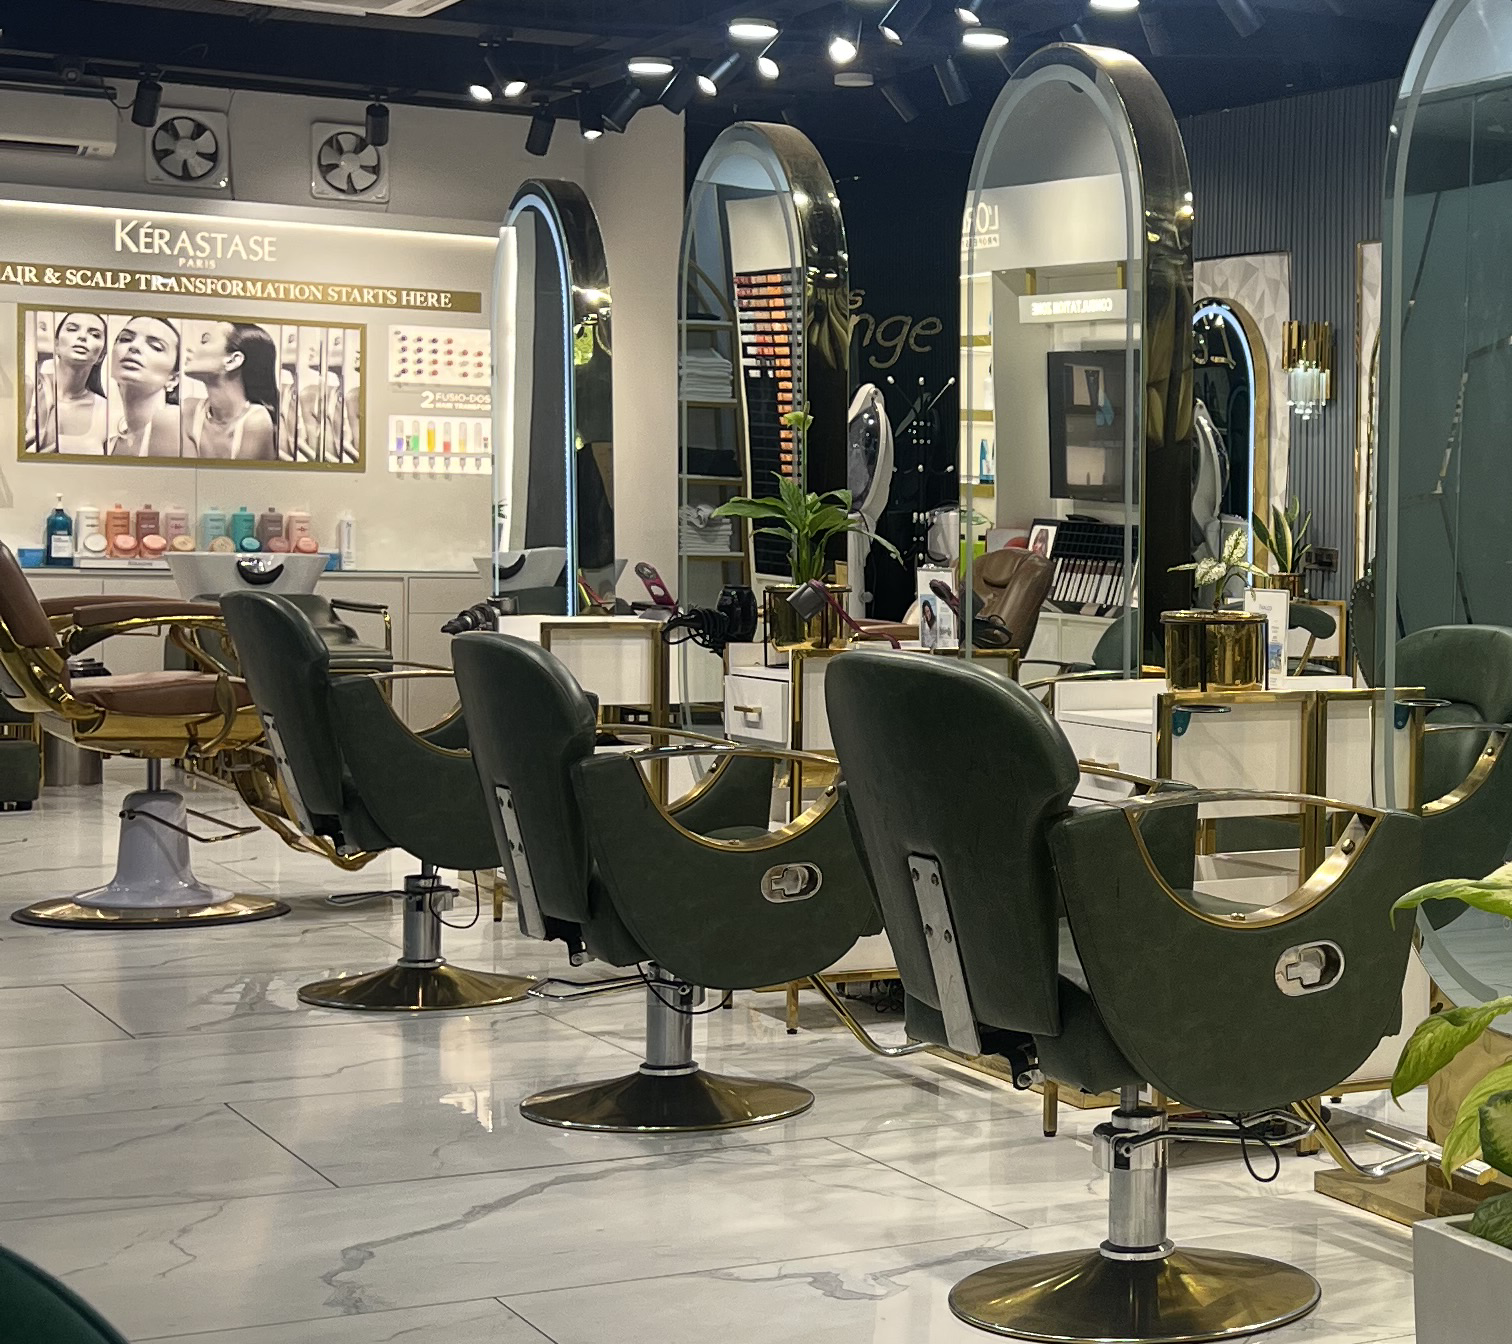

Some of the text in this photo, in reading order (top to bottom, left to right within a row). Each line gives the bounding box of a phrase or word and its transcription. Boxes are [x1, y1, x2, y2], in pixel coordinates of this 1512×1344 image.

[114, 219, 277, 262] KÉRASTASE
[179, 257, 216, 269] PARIS
[44, 267, 60, 285] &
[65, 269, 131, 289] SCALP
[136, 274, 323, 301] TRANSFORMATION
[327, 287, 397, 305] STARTS
[401, 290, 452, 308] HERE
[420, 390, 435, 408] 2
